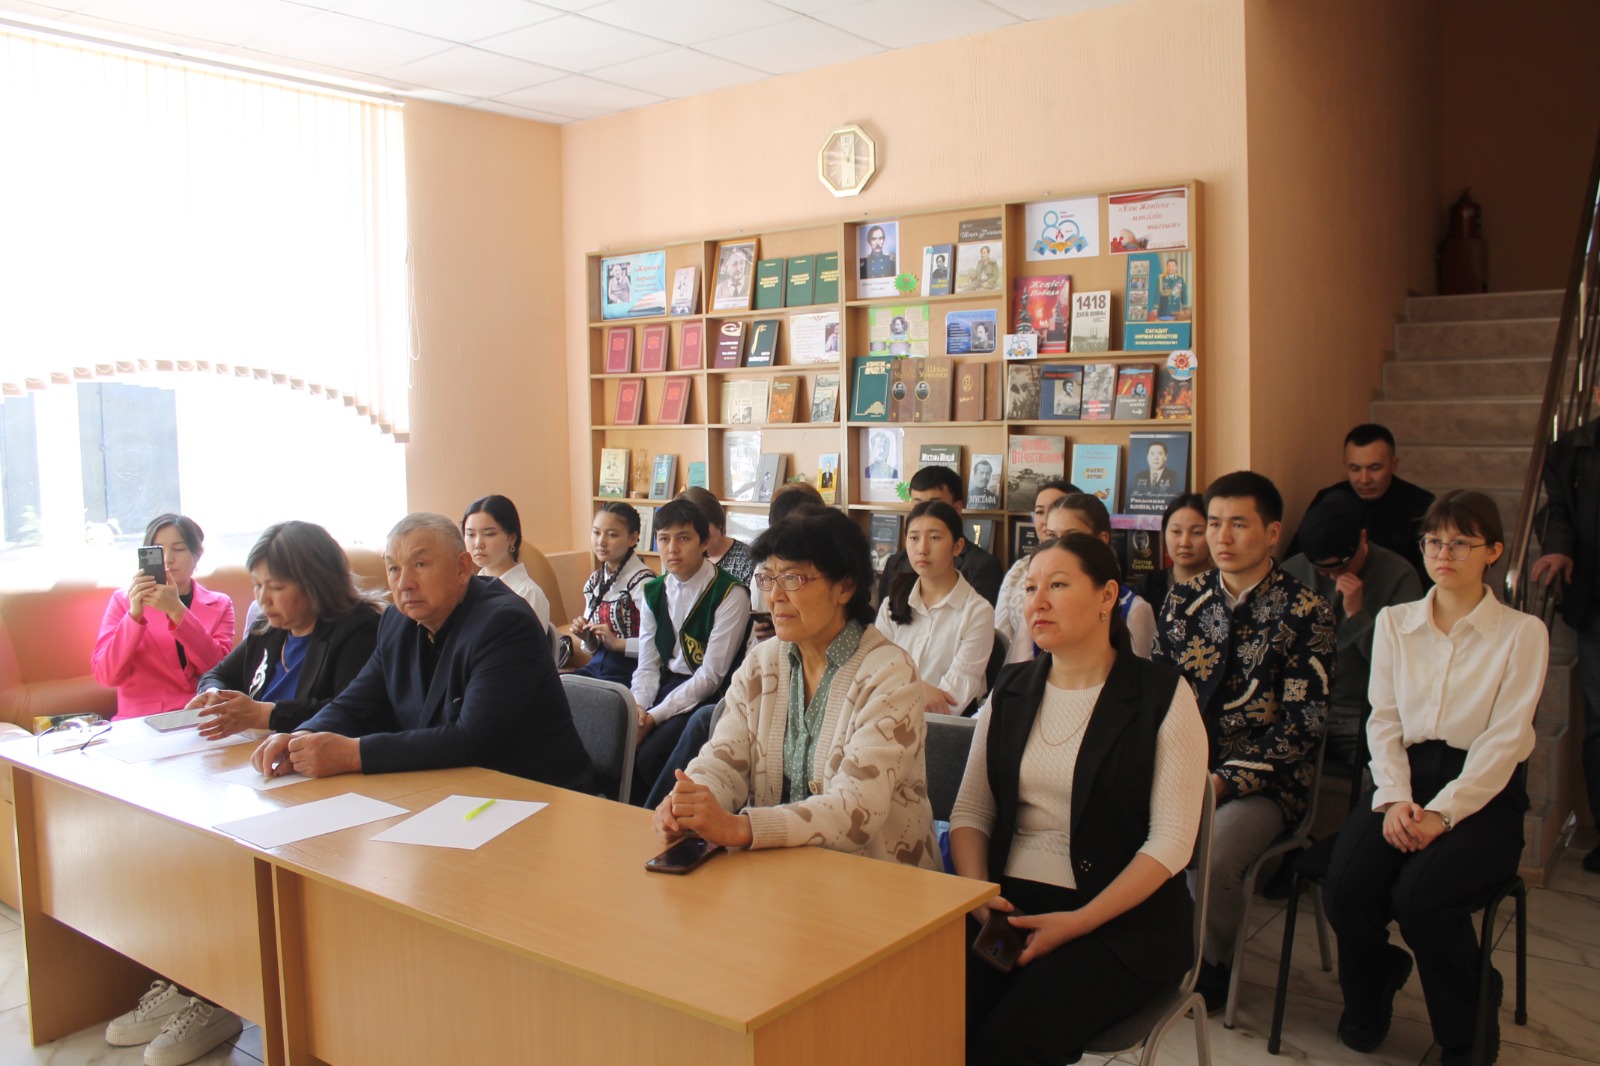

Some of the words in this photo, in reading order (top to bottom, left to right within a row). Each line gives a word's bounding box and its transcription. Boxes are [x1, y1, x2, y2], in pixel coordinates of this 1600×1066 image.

[1029, 279, 1066, 289] Жеңіс!
[1030, 288, 1066, 297] Победа!
[1076, 294, 1107, 310] 1418
